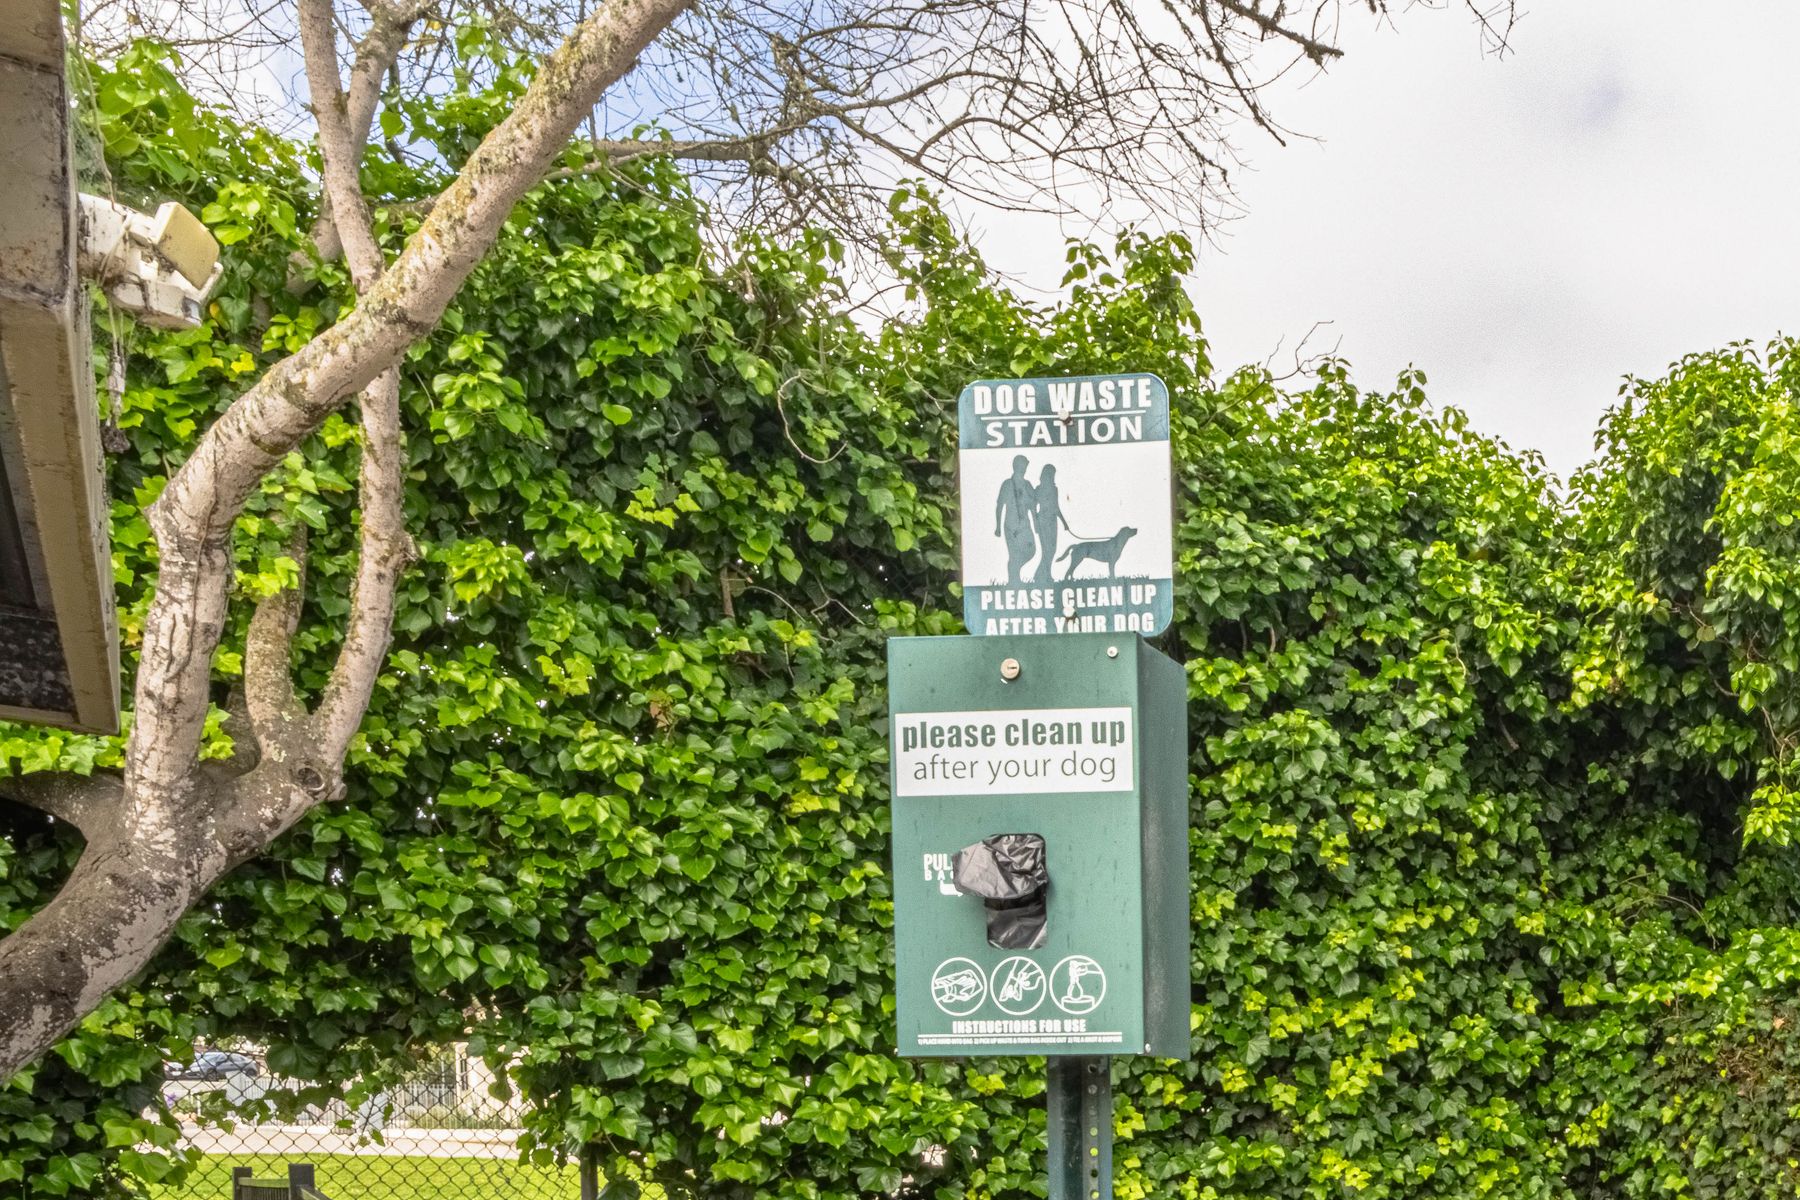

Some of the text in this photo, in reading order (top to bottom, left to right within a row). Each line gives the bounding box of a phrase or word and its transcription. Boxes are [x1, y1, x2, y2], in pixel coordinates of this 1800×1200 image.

[973, 378, 1152, 415] DOG WASTE
[986, 416, 1142, 447] STATION
[980, 584, 1157, 610] PLEASE CLEAN UP
[985, 613, 1154, 635] AFTER YOUR DOG
[903, 719, 1125, 752] please clean up
[914, 751, 1115, 785] after your dog
[923, 853, 954, 870] PUL
[924, 870, 954, 881] BA
[952, 1019, 1087, 1034] INSTRUCTIONS FOR USE
